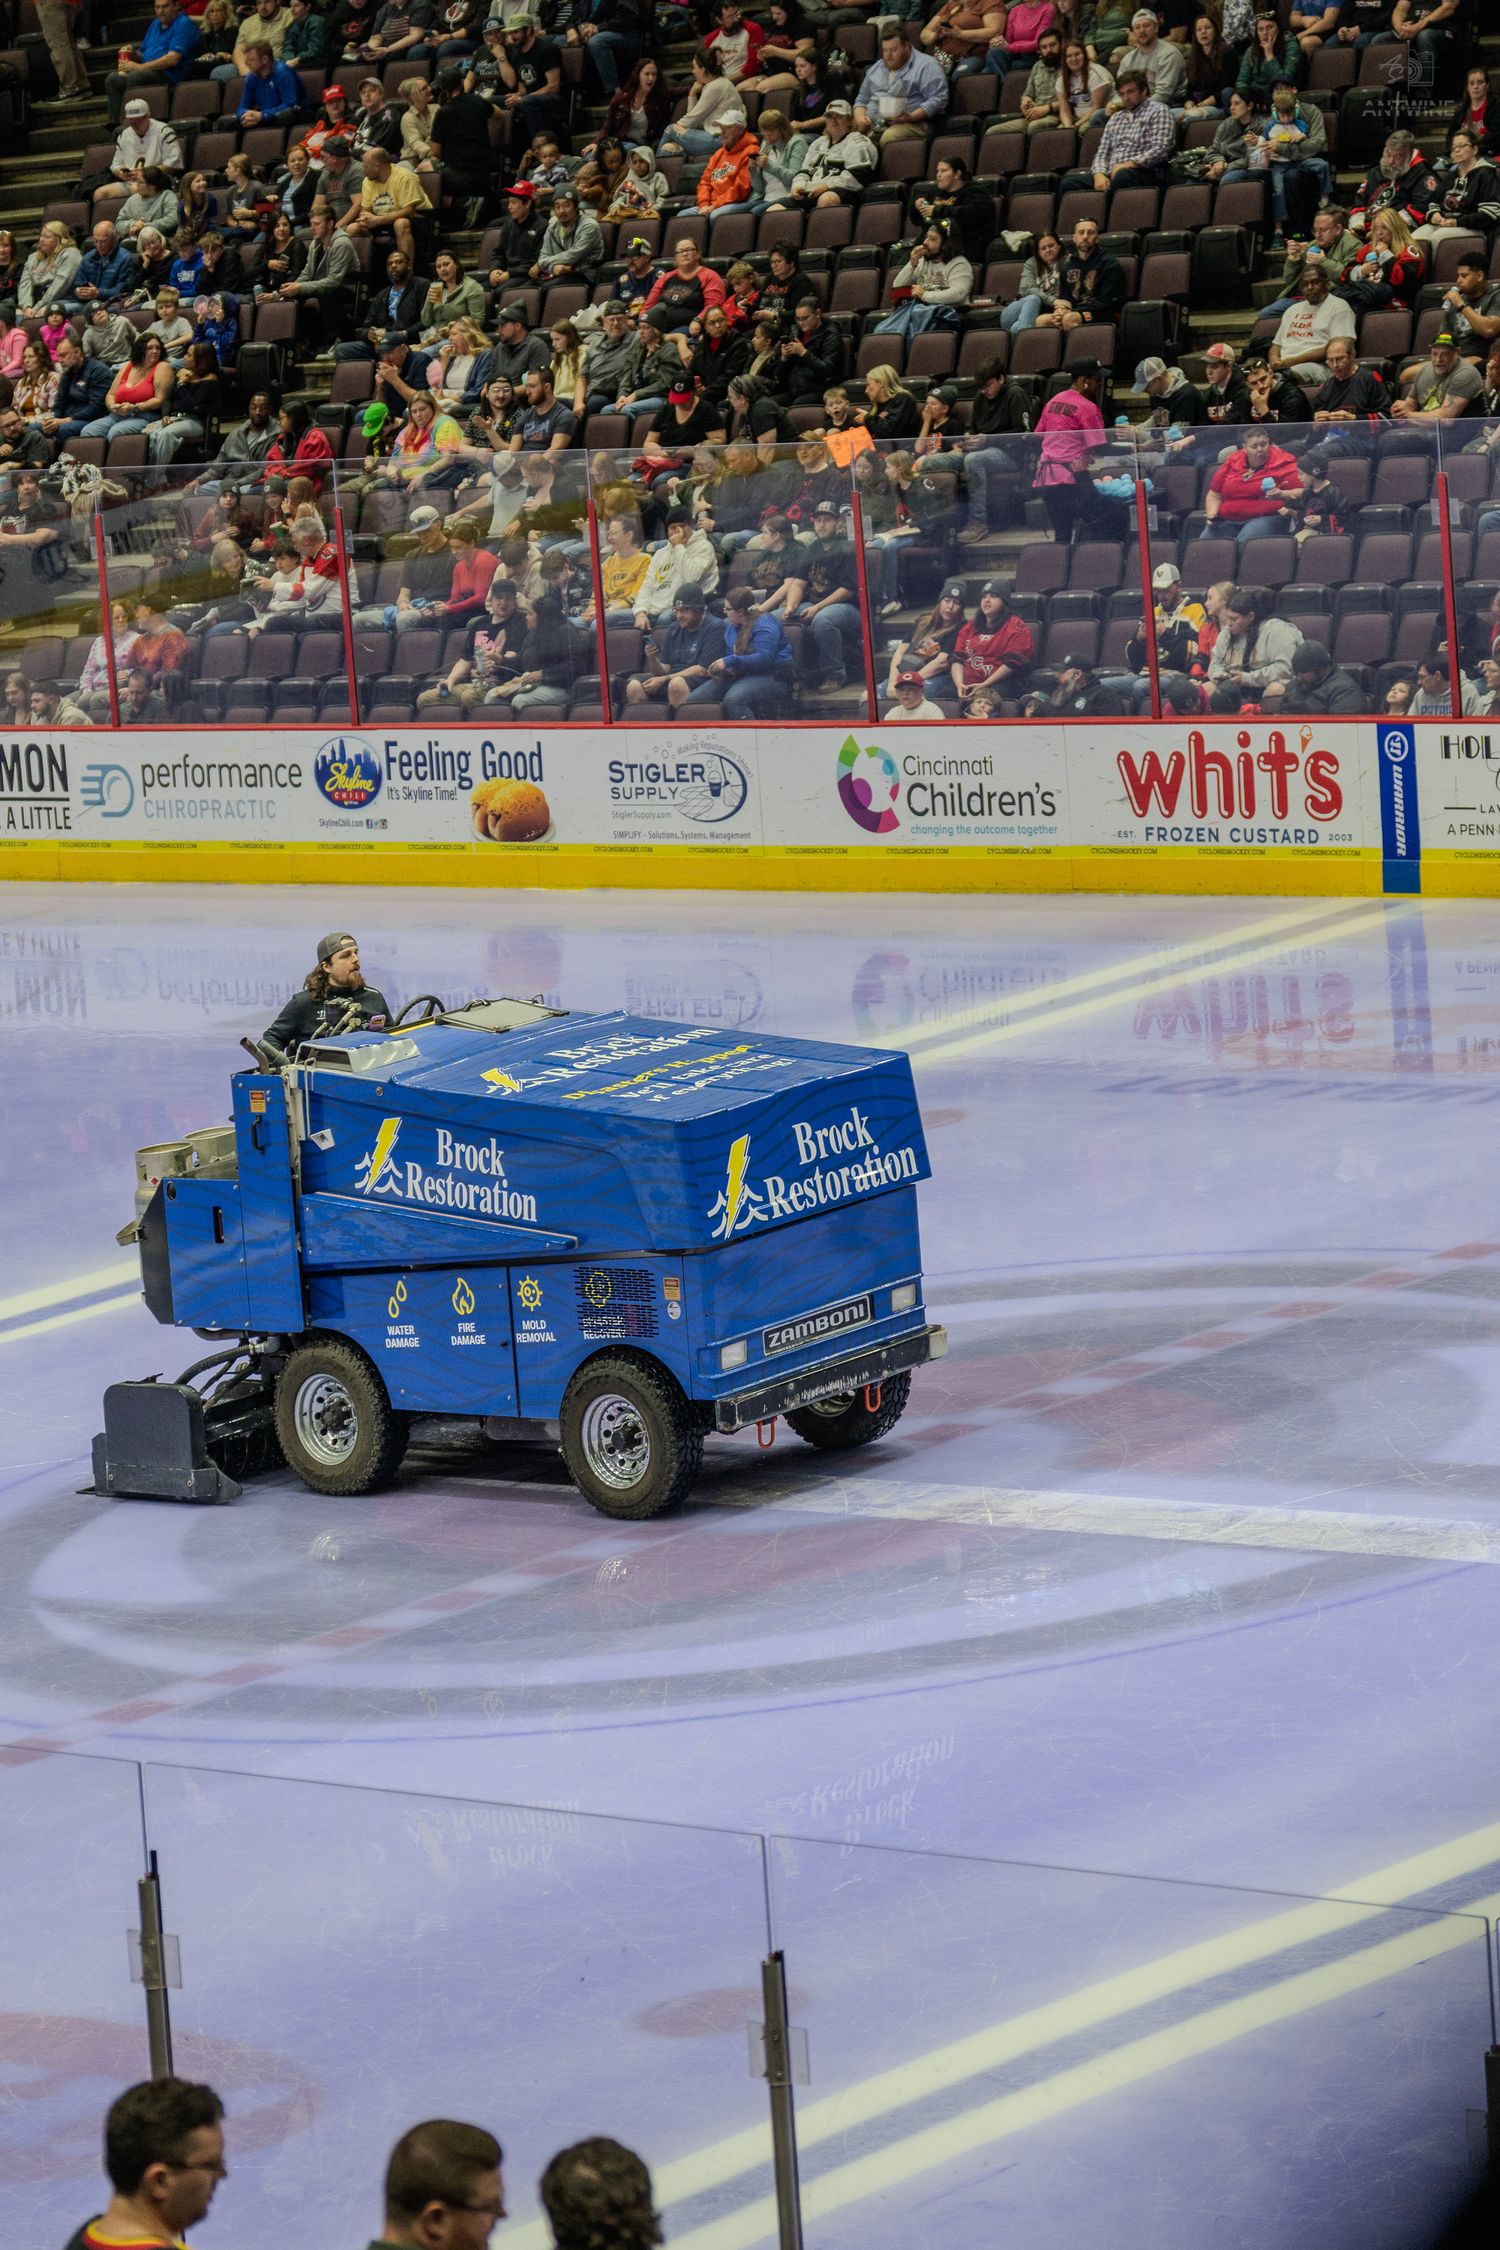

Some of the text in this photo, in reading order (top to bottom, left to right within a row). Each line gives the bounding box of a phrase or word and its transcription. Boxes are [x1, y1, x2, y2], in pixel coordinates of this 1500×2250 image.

[384, 740, 544, 790] Feeling Good
[608, 760, 706, 784] STIGLER
[903, 755, 993, 776] Cincinnati
[141, 754, 302, 797] performance
[325, 762, 375, 792] Skyline
[334, 791, 366, 799] CHILI
[387, 786, 458, 803] It's Skyline Time!
[610, 787, 679, 800] SUPPLY
[906, 782, 1057, 817] Children's
[7, 806, 72, 830] A LITTLE
[144, 799, 277, 820] CHIROPRACTIC
[611, 810, 672, 821] StiglerSupply.com
[613, 830, 641, 839] SIMPLIFY
[709, 831, 751, 841] Management
[910, 824, 1058, 837] changing the outcome together
[1117, 827, 1353, 844] EST. FROZEN CUSTARD 2003
[1447, 823, 1494, 836] A PENN
[540, 1029, 722, 1079] Restoration
[792, 1106, 875, 1166] Brock
[436, 1128, 506, 1177] Brock
[405, 1161, 538, 1222] Restoration
[763, 1145, 919, 1219] Restoration
[387, 1325, 415, 1336] WATER
[457, 1322, 476, 1333] FIRE
[522, 1320, 547, 1330] MOLD
[768, 1303, 867, 1348] ZAMBONI
[385, 1337, 420, 1348] DAMAGE
[451, 1334, 486, 1346] DAMAGE
[516, 1332, 557, 1343] REMOVAL
